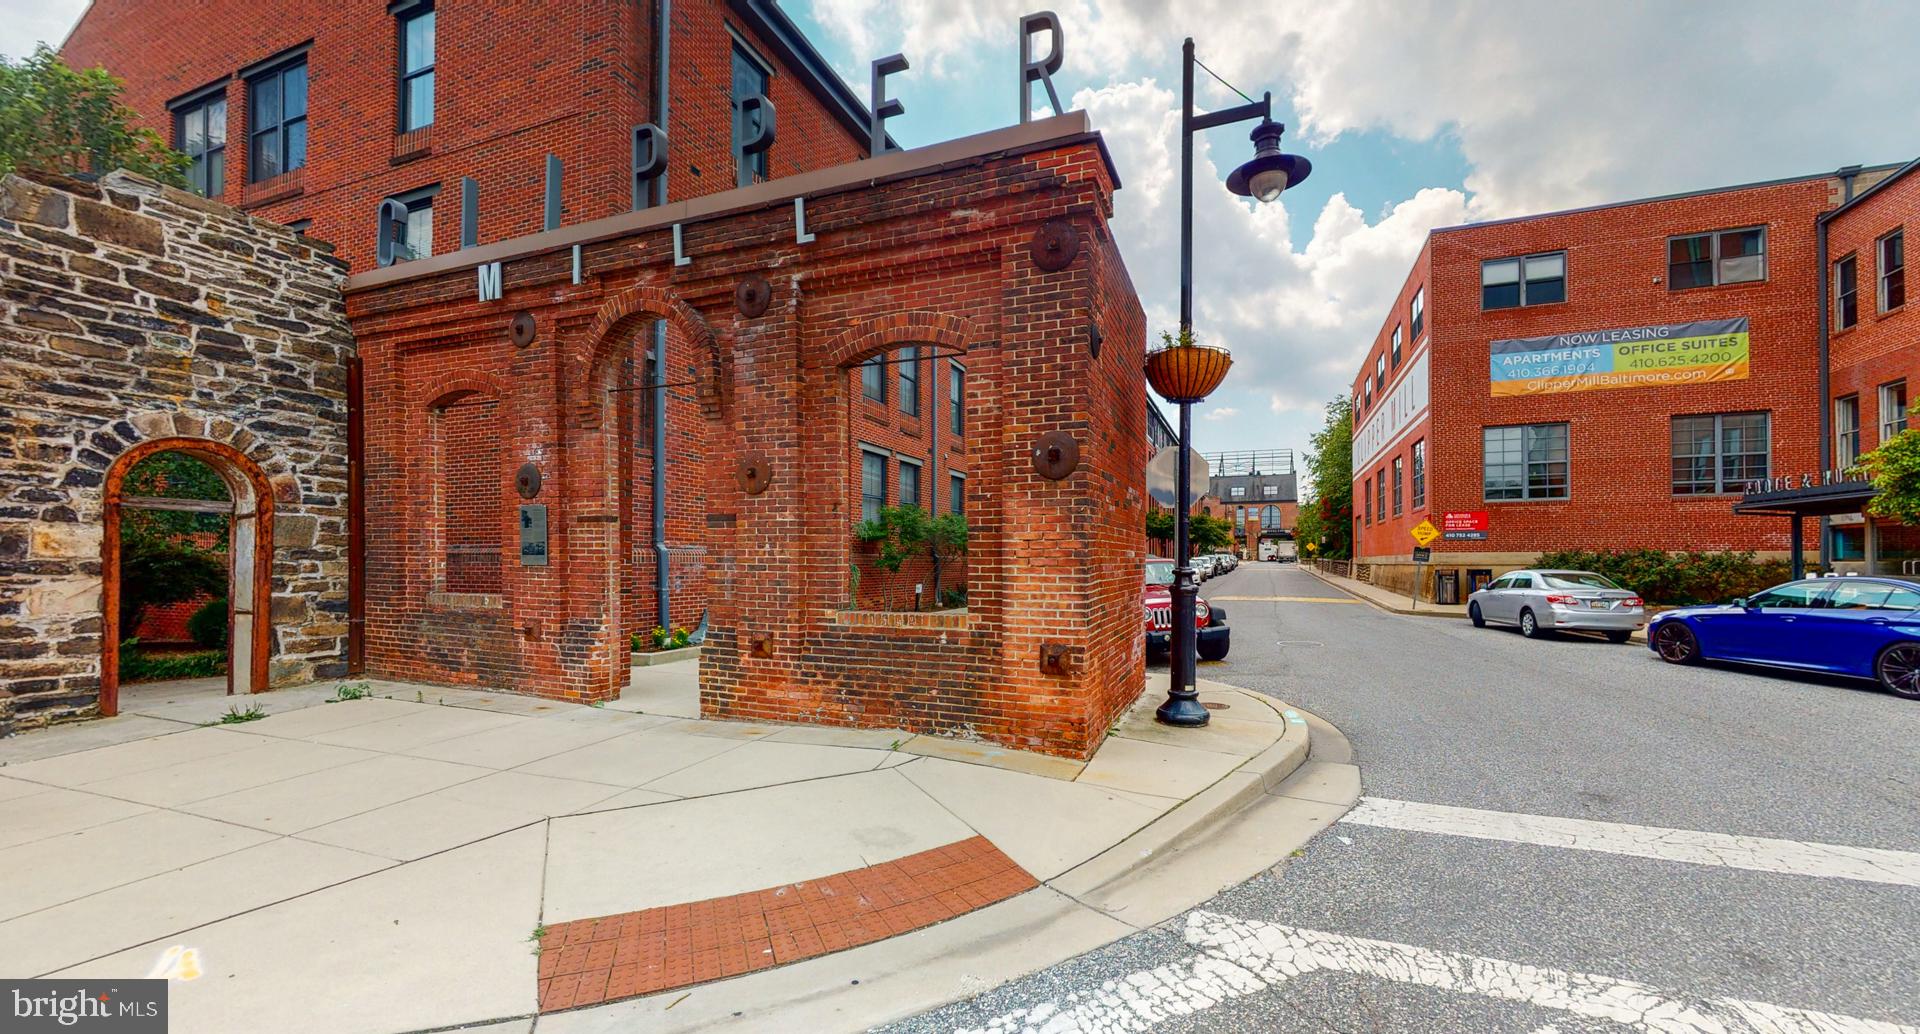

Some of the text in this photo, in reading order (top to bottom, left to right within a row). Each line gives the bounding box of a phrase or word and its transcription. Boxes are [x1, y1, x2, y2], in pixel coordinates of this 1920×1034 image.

[478, 197, 815, 302] MILL
[1559, 327, 1669, 346] NOW LEASING
[1618, 336, 1738, 355] OFFICE SUITES
[1503, 348, 1601, 366] APARTMENTS
[1629, 352, 1732, 369] 410.625.4200
[1507, 362, 1595, 378] 410.366.1904
[1527, 369, 1706, 392] ClipperMillBaltimore.com
[1391, 375, 1416, 432] MILL
